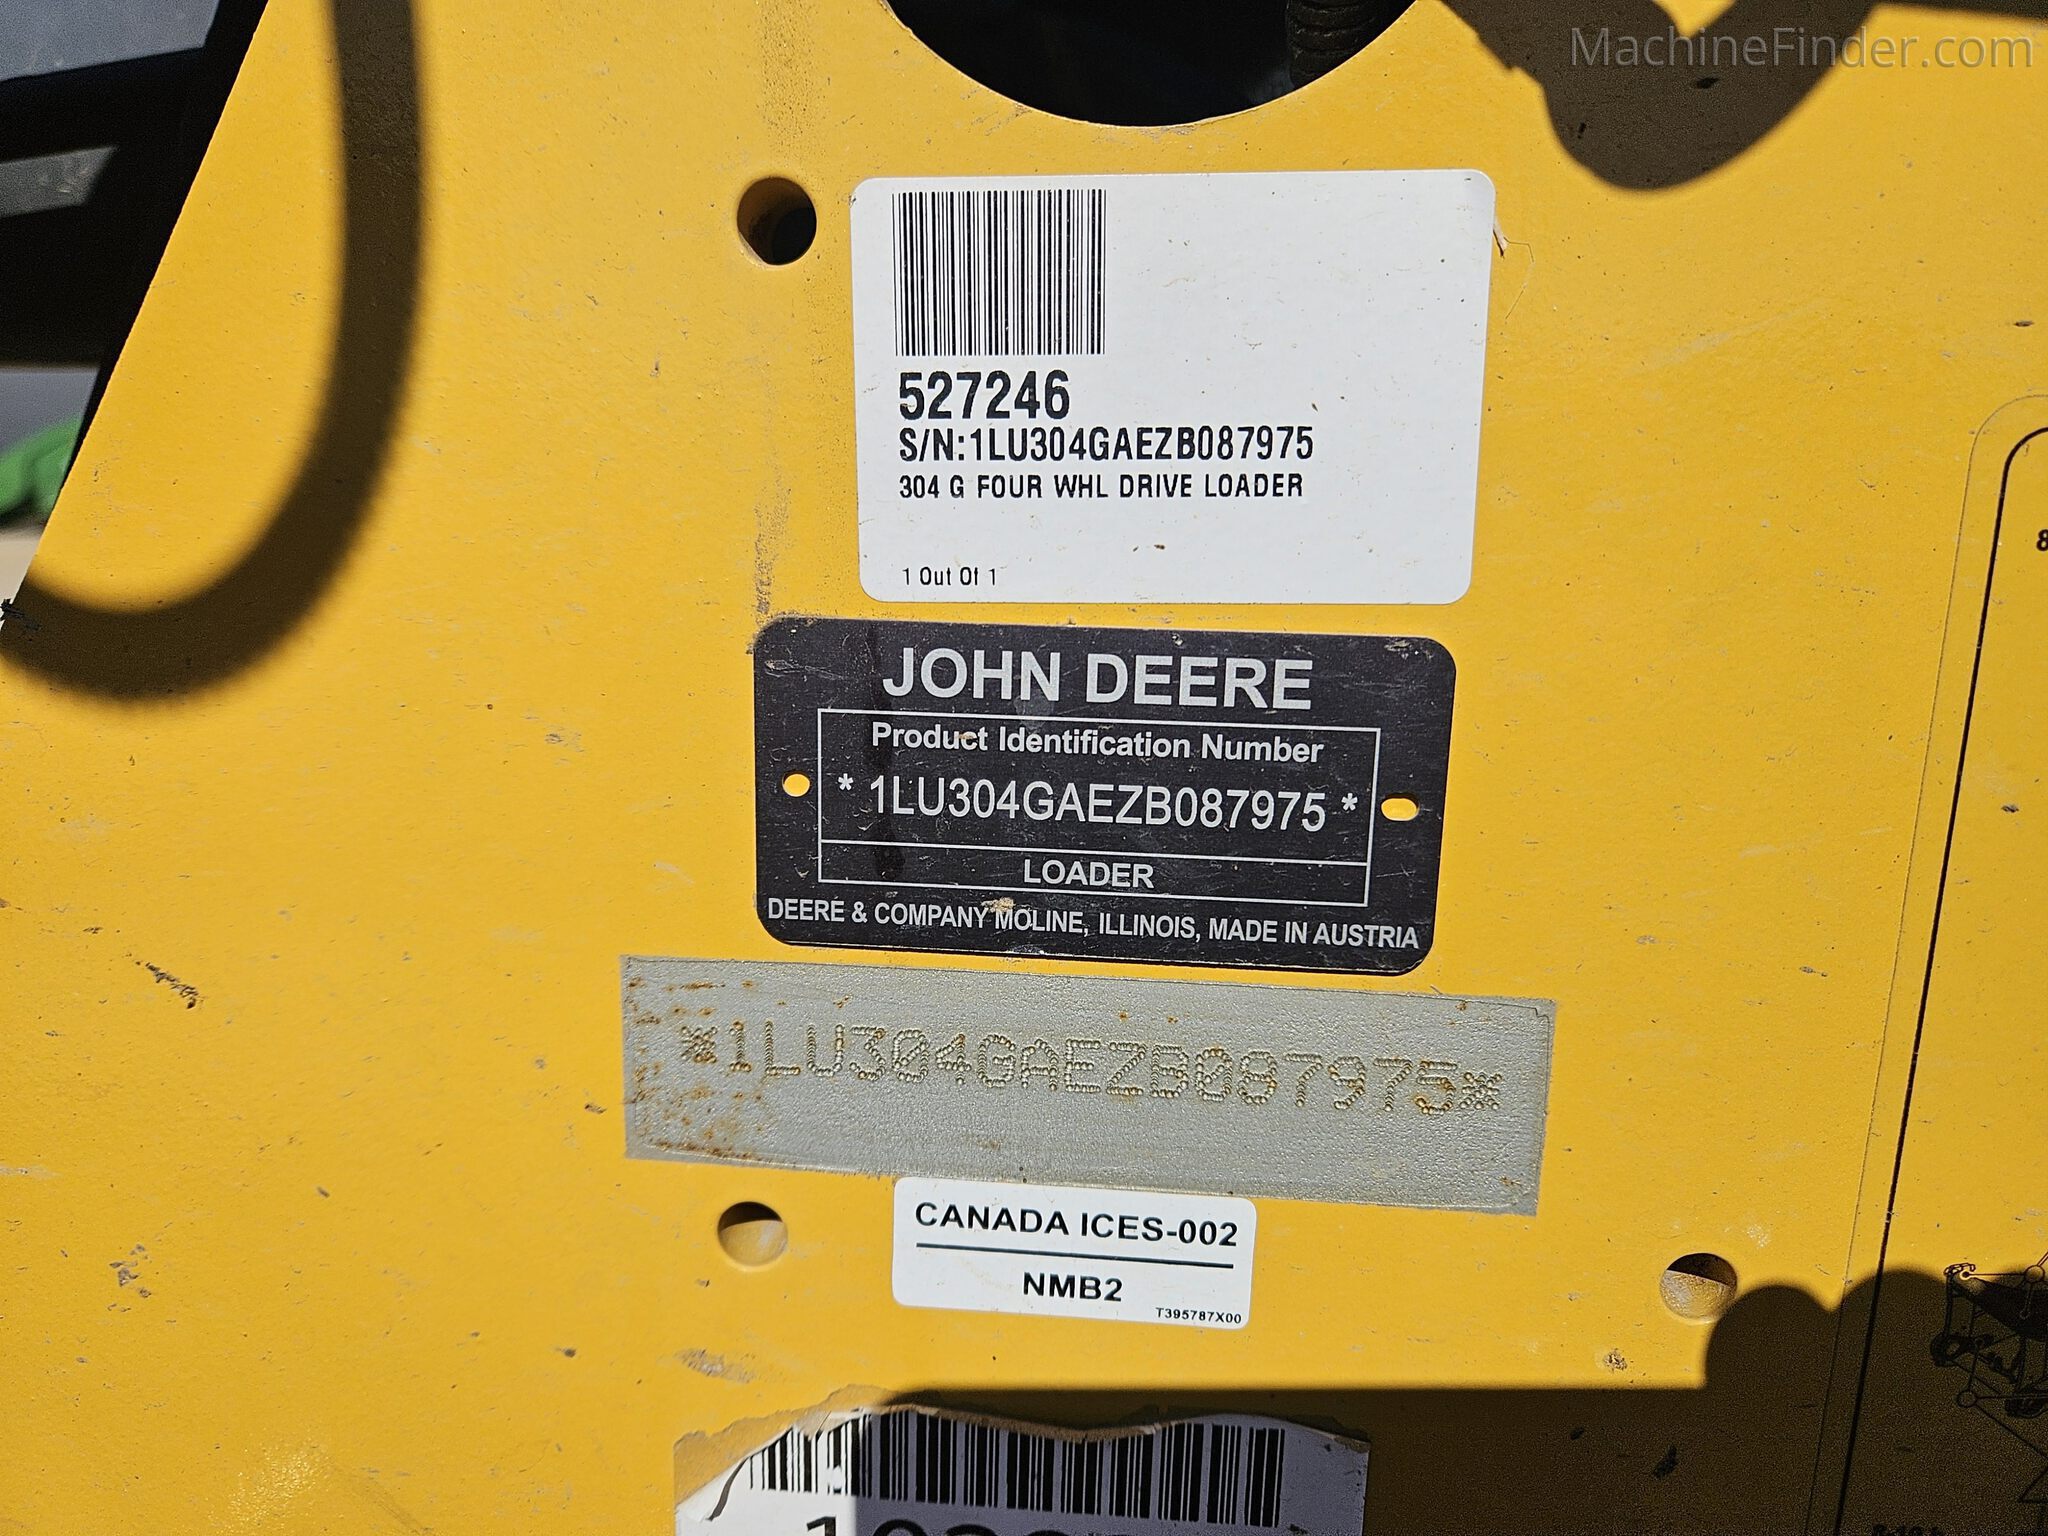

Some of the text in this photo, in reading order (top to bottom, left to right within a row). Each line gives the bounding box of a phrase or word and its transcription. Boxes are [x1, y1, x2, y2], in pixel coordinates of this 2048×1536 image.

[900, 369, 1070, 420] 527246
[899, 426, 1314, 462] S/N:1LU304GAEZB087975
[899, 472, 1303, 499] 304 G FOUR WHL DRIVE LOADER
[901, 566, 996, 586] 1 Out Of 1
[882, 647, 1313, 710] JOHN DEERE
[872, 721, 1325, 764] Product Identification Number
[869, 774, 1326, 832] 1LU304GAEZB087975
[1022, 858, 1155, 890] LOADER
[768, 897, 1420, 950] DEERE & COMPANY MOLINE, ILLINOIS, MADE IN AUSTRIA
[915, 1202, 1239, 1247] CANADA ICES-002
[1023, 1272, 1124, 1302] NMB2
[1156, 1307, 1243, 1325] T395787X00
